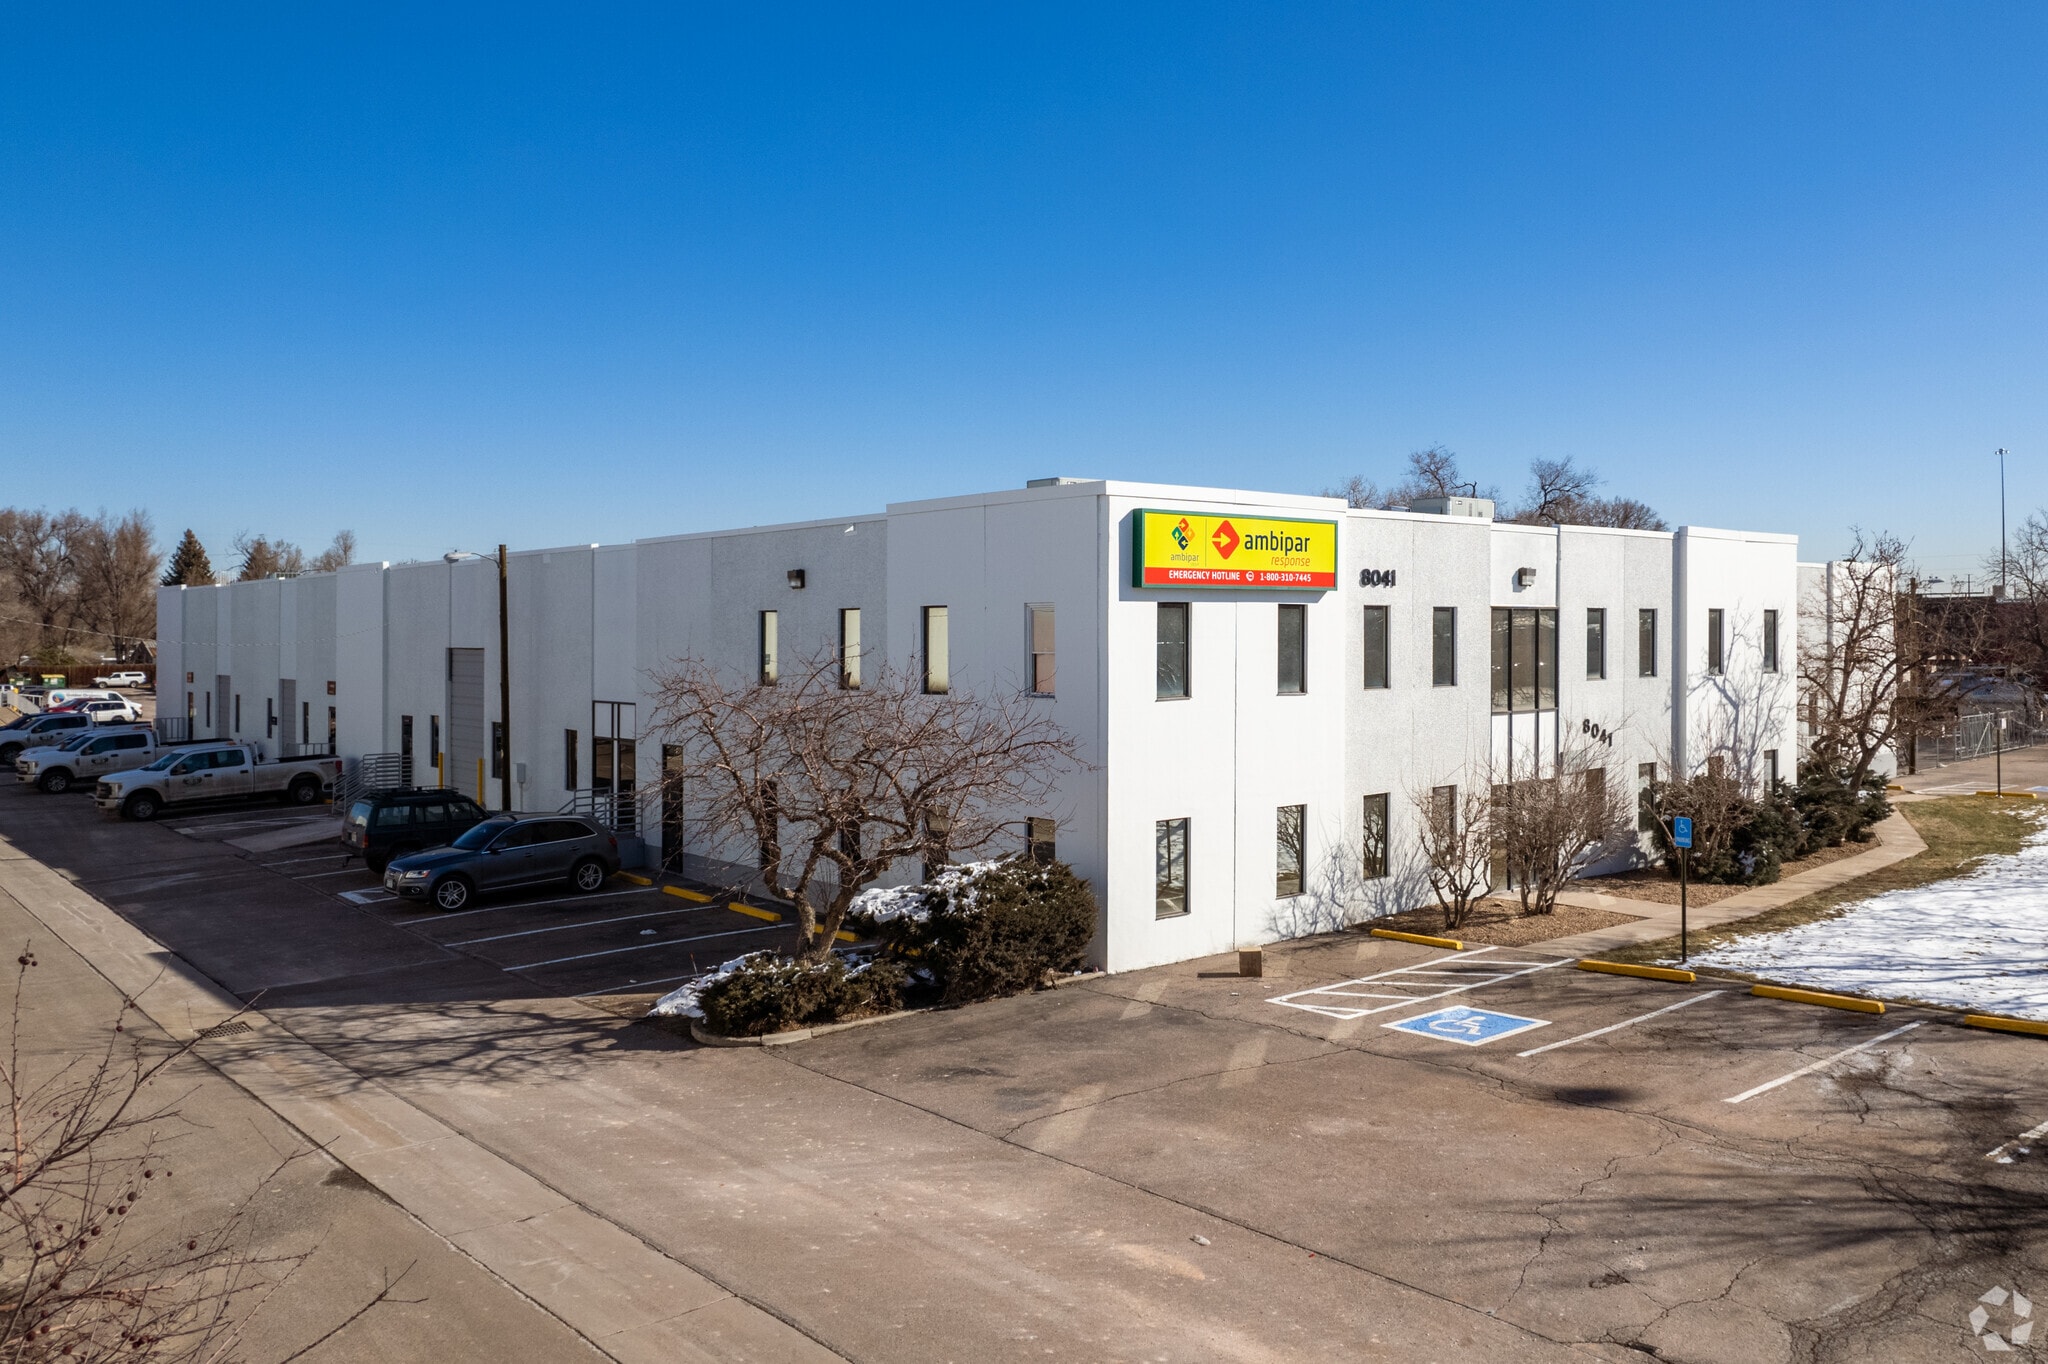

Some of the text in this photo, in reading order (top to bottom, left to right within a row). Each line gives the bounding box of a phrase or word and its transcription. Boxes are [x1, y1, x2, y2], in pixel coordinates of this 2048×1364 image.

[1244, 531, 1311, 556] ambipar
[1170, 552, 1199, 563] ambipar
[1271, 556, 1311, 568] response
[1168, 569, 1312, 583] EMERGENCY HOTLINE 1-800-310-7445
[1359, 568, 1397, 588] 8041
[1582, 718, 1613, 748] 8041
